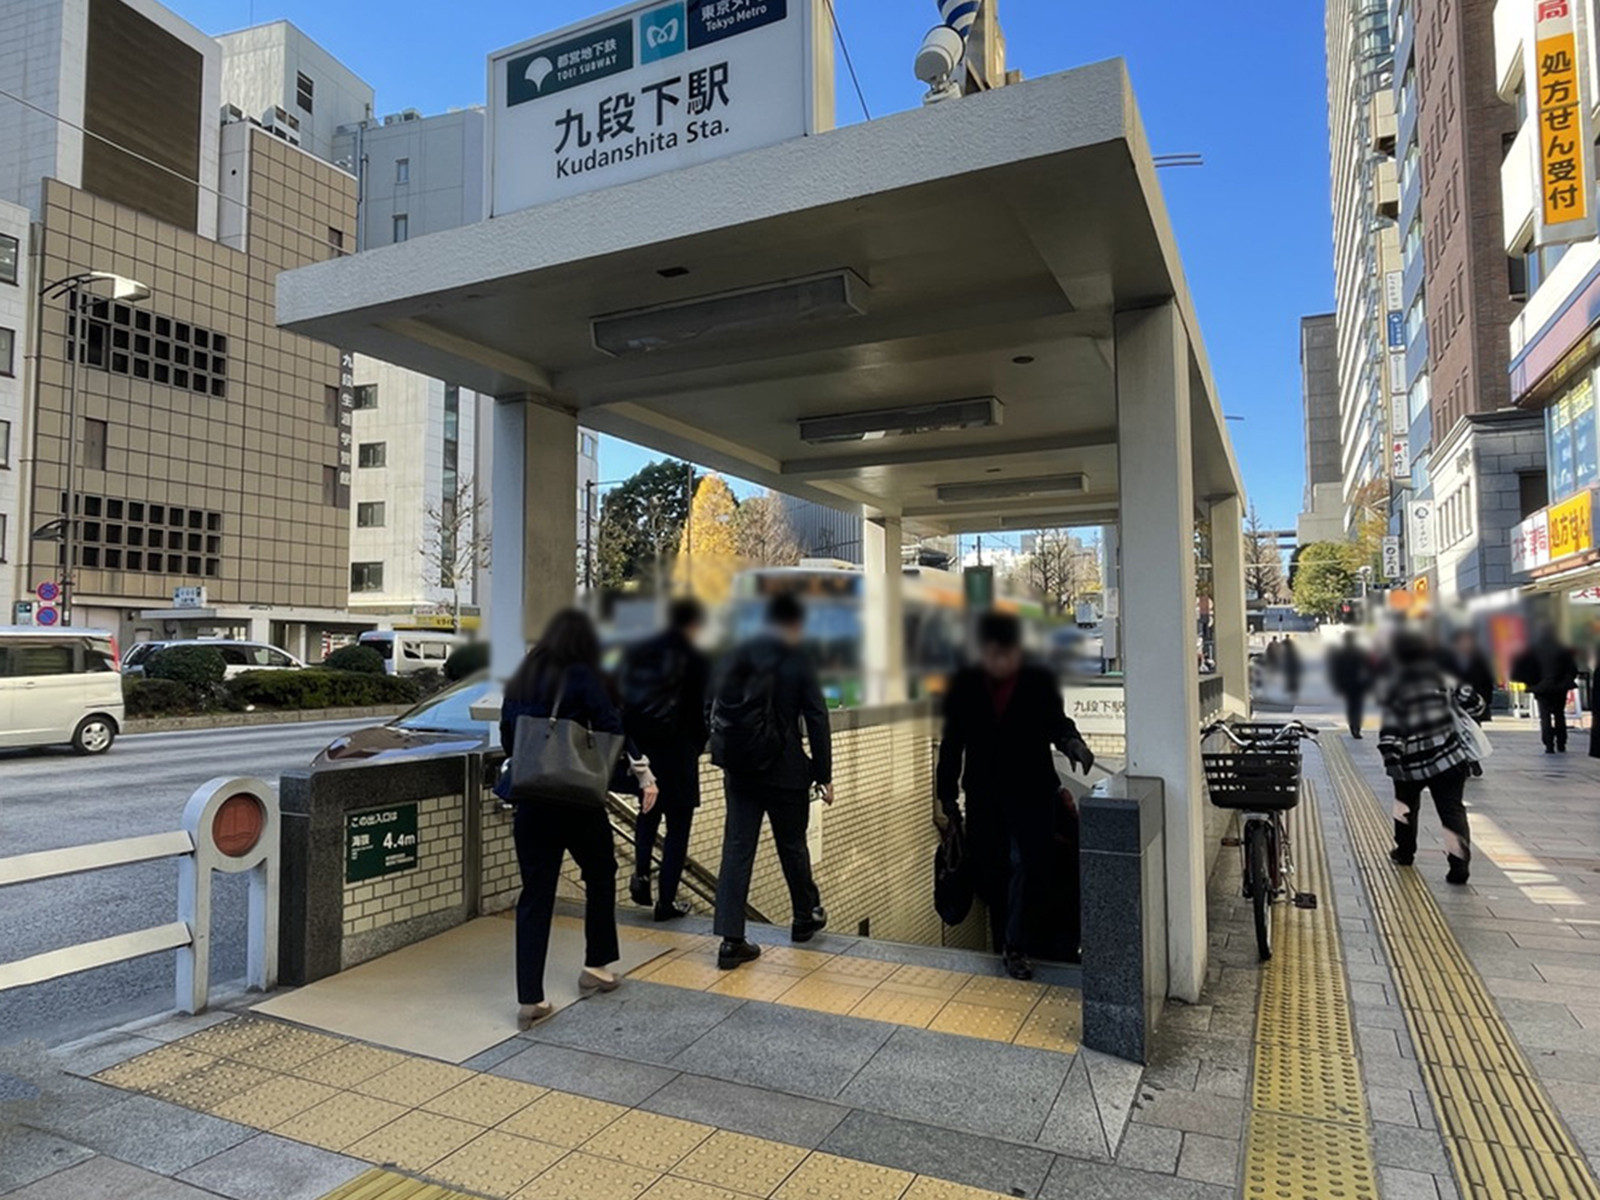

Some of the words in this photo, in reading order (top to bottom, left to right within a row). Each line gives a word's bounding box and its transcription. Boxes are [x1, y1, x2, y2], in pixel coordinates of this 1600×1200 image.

[701, 0, 766, 20] 東京メ
[706, 15, 735, 32] Tokyo
[736, 5, 767, 21] Metro
[557, 38, 617, 68] 都営地下鉄
[557, 66, 577, 81] TOEI
[579, 54, 617, 74] SUBWAY
[554, 61, 730, 154] 九段下駅
[1541, 50, 1579, 210] 処方せん受付
[556, 132, 678, 179] Kudanshita
[686, 119, 730, 143] Sta.
[1073, 700, 1125, 713] 九段下駅
[382, 832, 416, 849] 4.4m
